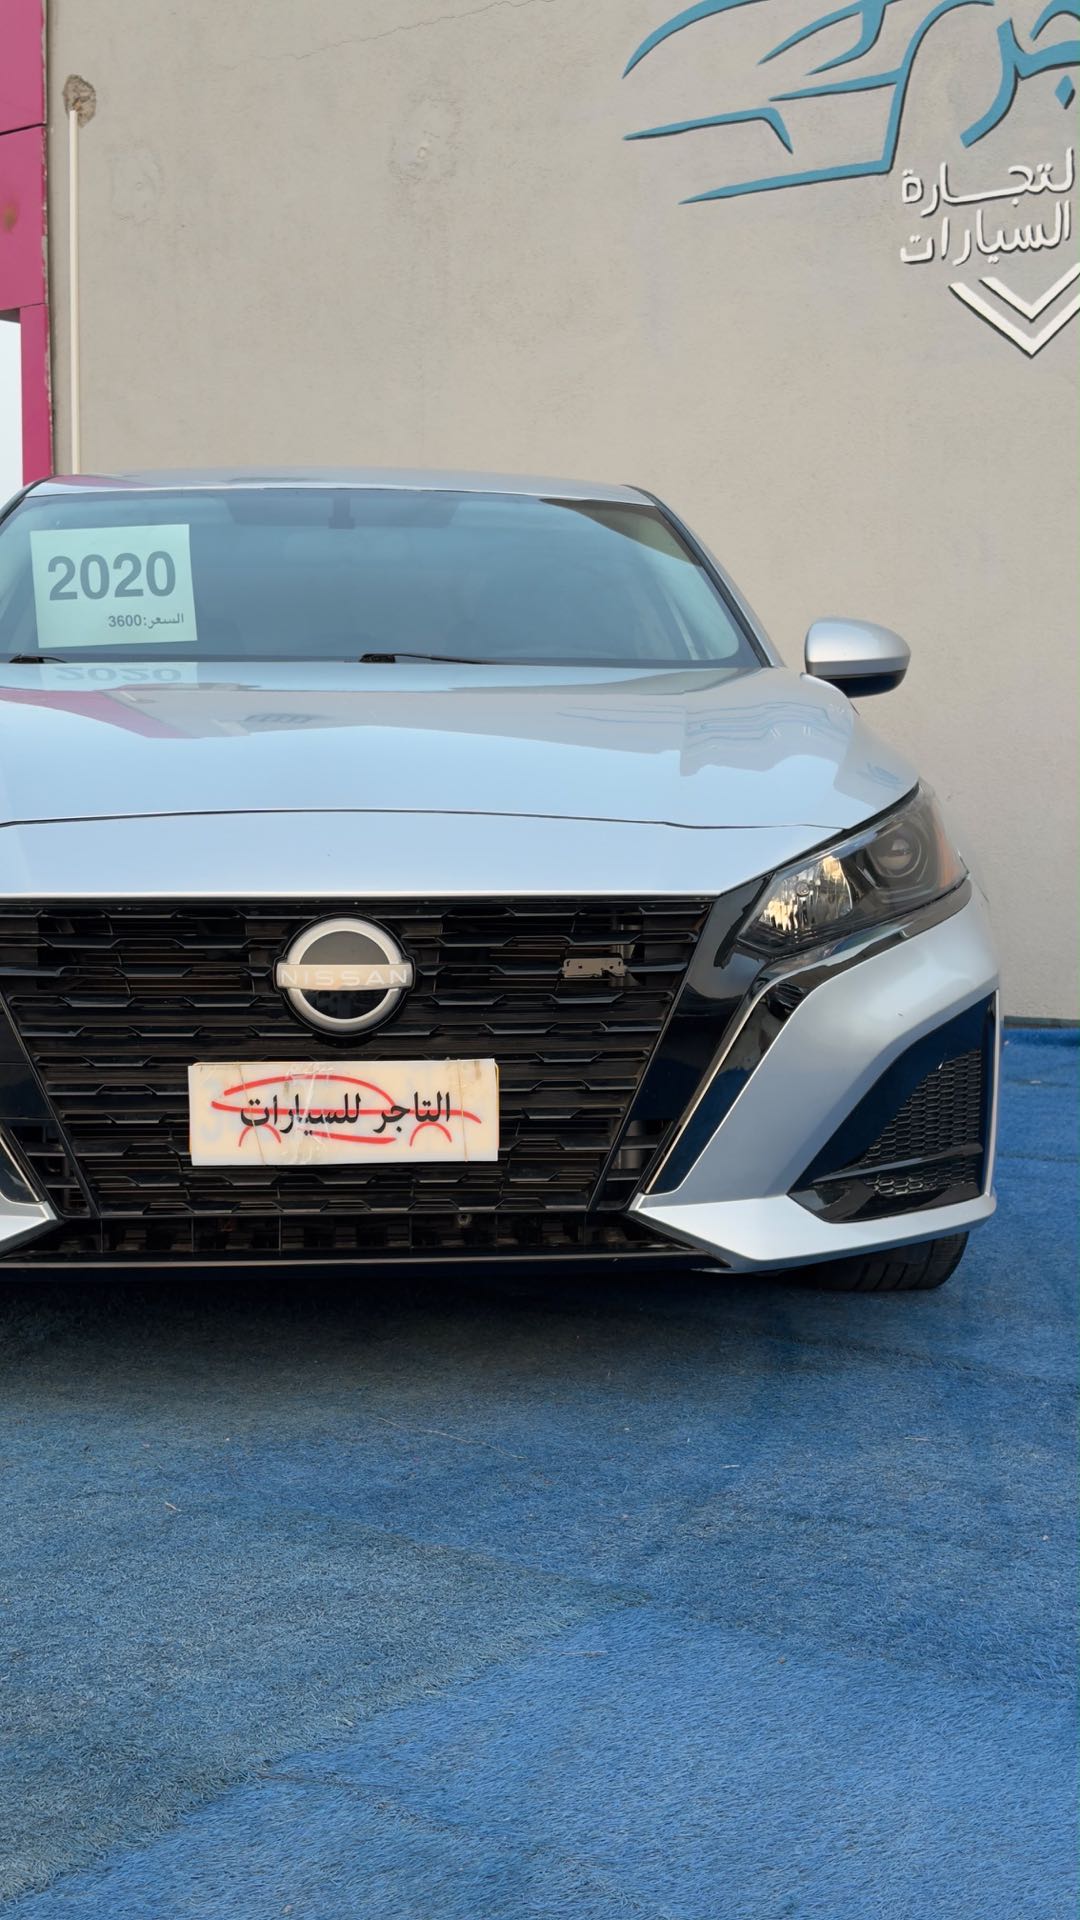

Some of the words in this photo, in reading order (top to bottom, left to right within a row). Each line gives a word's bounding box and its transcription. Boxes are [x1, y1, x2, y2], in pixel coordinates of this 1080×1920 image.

[901, 146, 1074, 217] لتجارة
[900, 200, 1071, 266] السيارات
[47, 550, 176, 601] 2020
[281, 969, 407, 986] NISSAN
[240, 1092, 361, 1137] للسيارات
[372, 1091, 451, 1134] التاجر
